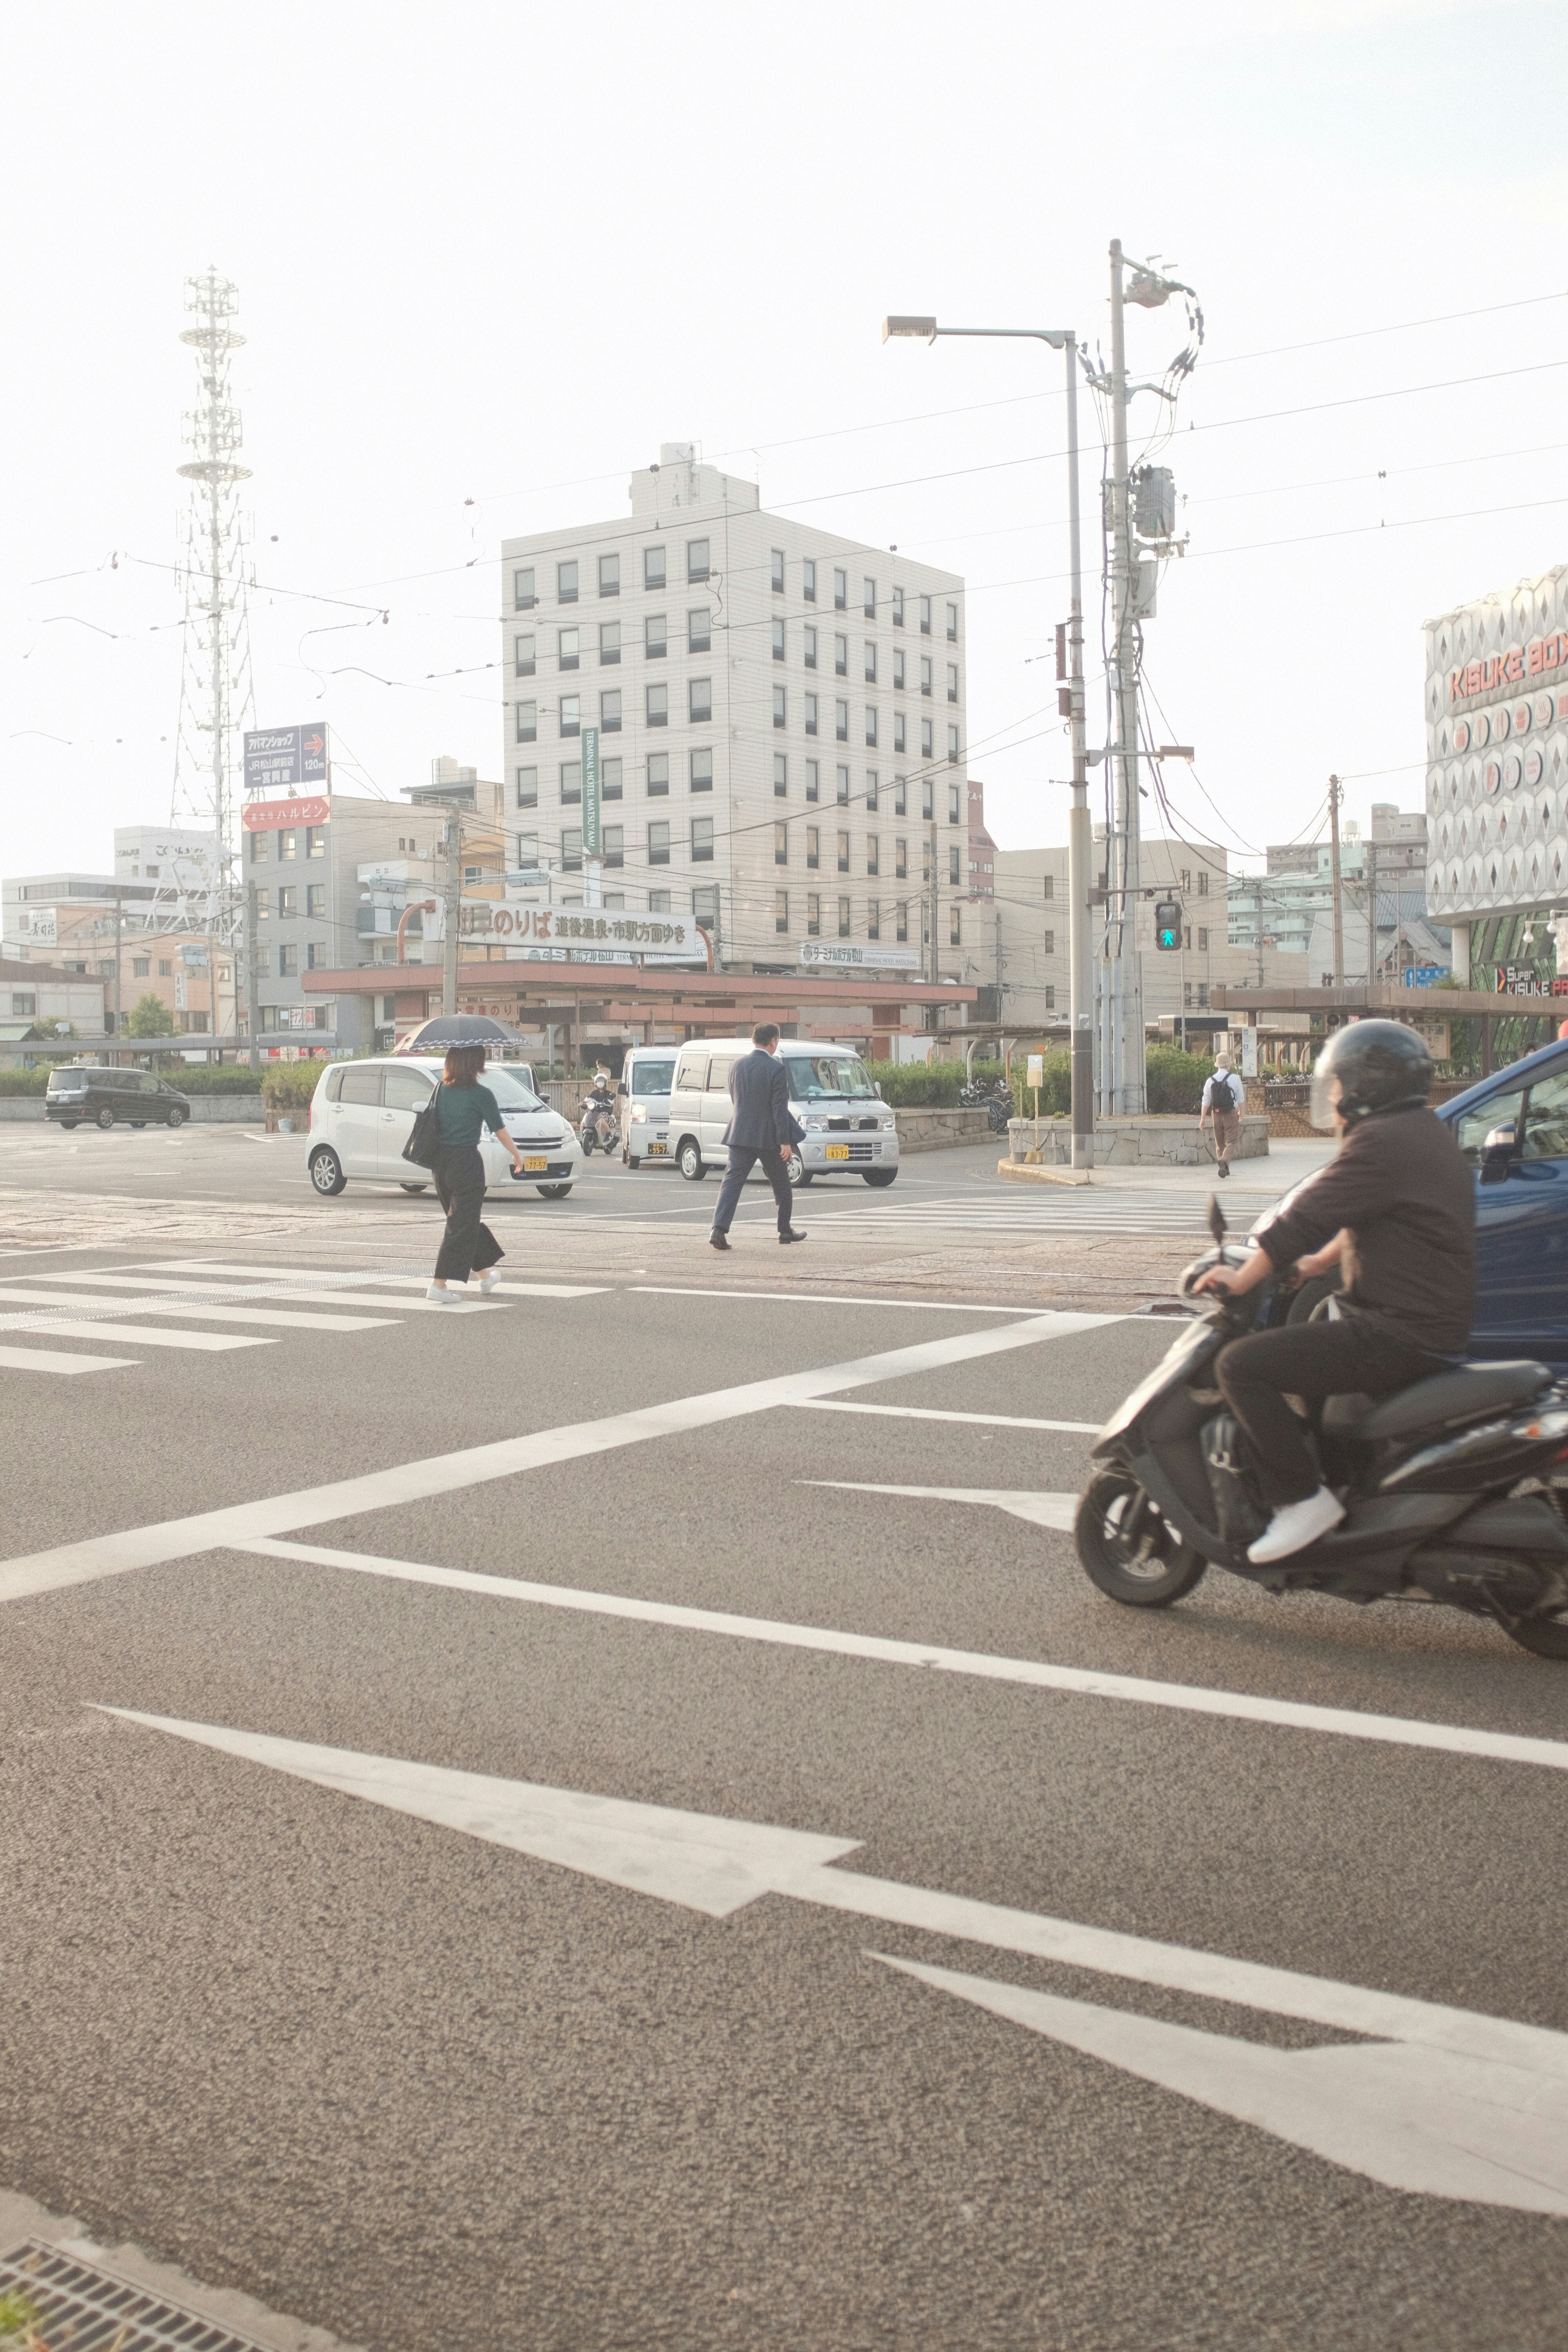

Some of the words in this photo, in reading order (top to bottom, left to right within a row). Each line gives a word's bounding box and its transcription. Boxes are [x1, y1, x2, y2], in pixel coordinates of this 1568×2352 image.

[1450, 646, 1524, 701] KISUKE
[1529, 633, 1568, 675] BOX
[249, 732, 295, 750] アパマンショップ
[586, 731, 594, 770] TERMINAL
[249, 756, 295, 771] JR松山駅前店
[305, 759, 325, 770] 120m
[586, 771, 595, 797] HOTEL
[555, 916, 685, 944] 道後温泉・市駅方面ゆき
[814, 947, 863, 963] ターミナルホテル松山
[1507, 981, 1550, 997] KISUKE
[529, 1162, 546, 1170] 77-57
